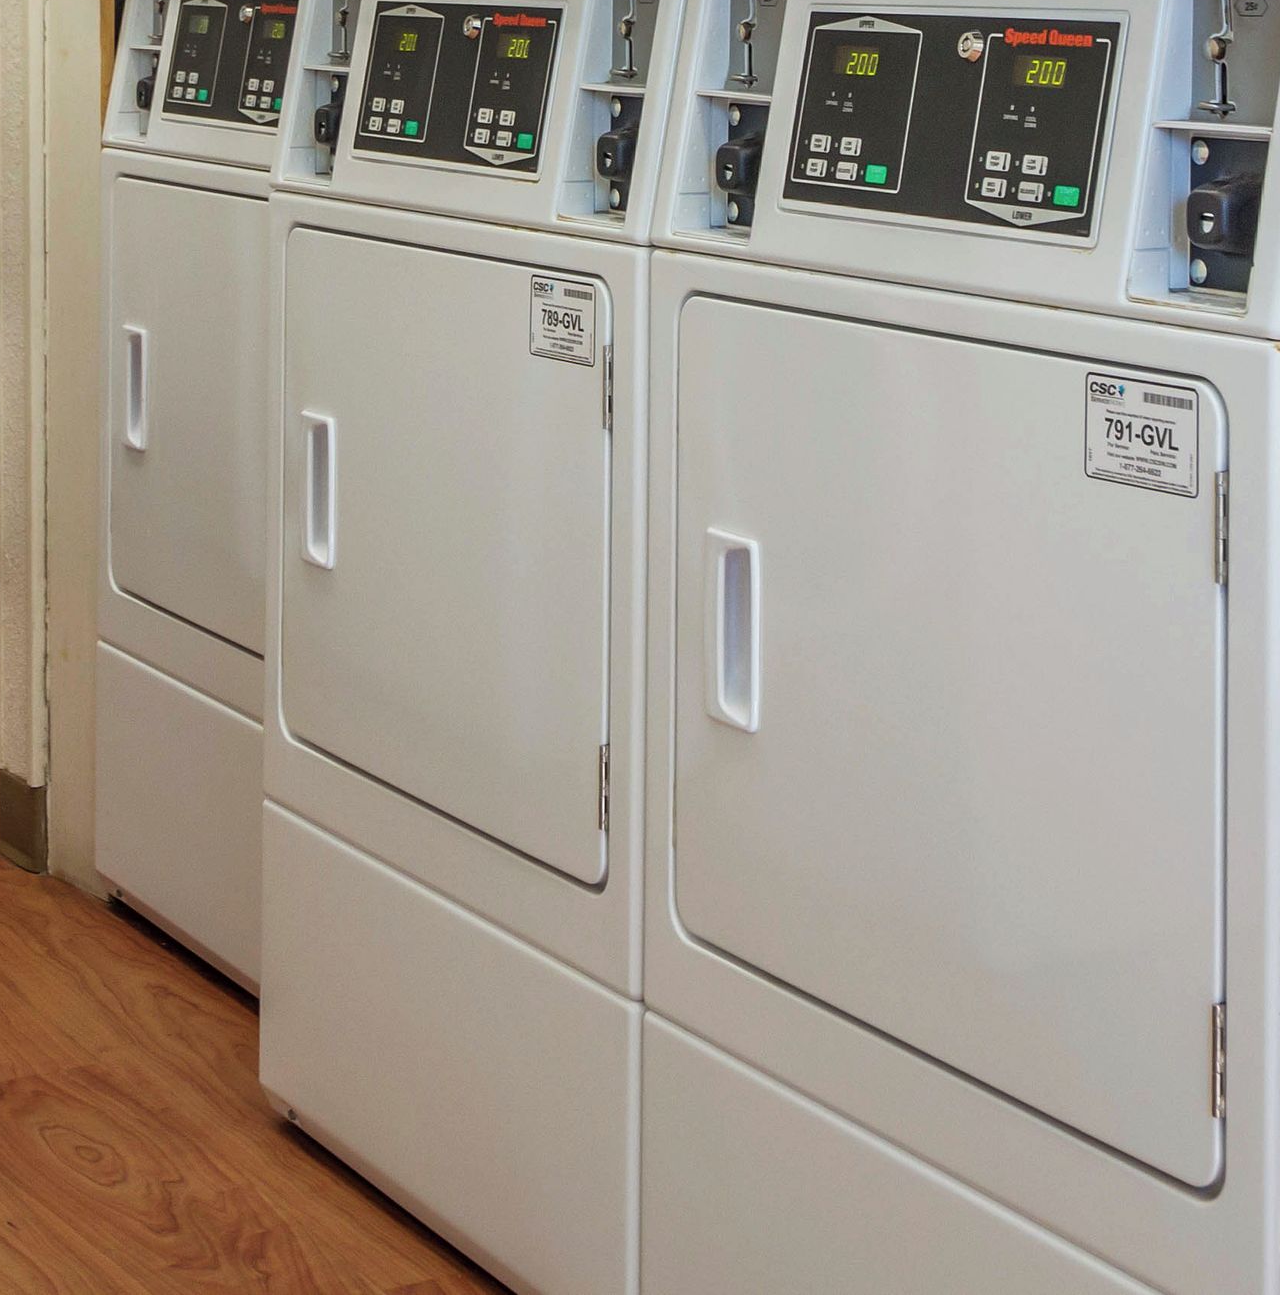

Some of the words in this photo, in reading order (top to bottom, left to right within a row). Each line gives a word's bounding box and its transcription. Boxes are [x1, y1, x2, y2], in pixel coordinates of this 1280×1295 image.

[1004, 27, 1048, 48] Speed
[1048, 29, 1094, 48] Queen
[846, 53, 879, 76] 200
[1026, 60, 1066, 86] 200
[1012, 210, 1033, 221] LOWER
[533, 281, 550, 293] CSC
[541, 308, 584, 332] 789-GVL
[1089, 381, 1117, 396] CSC
[1104, 417, 1179, 452] 791-GVL
